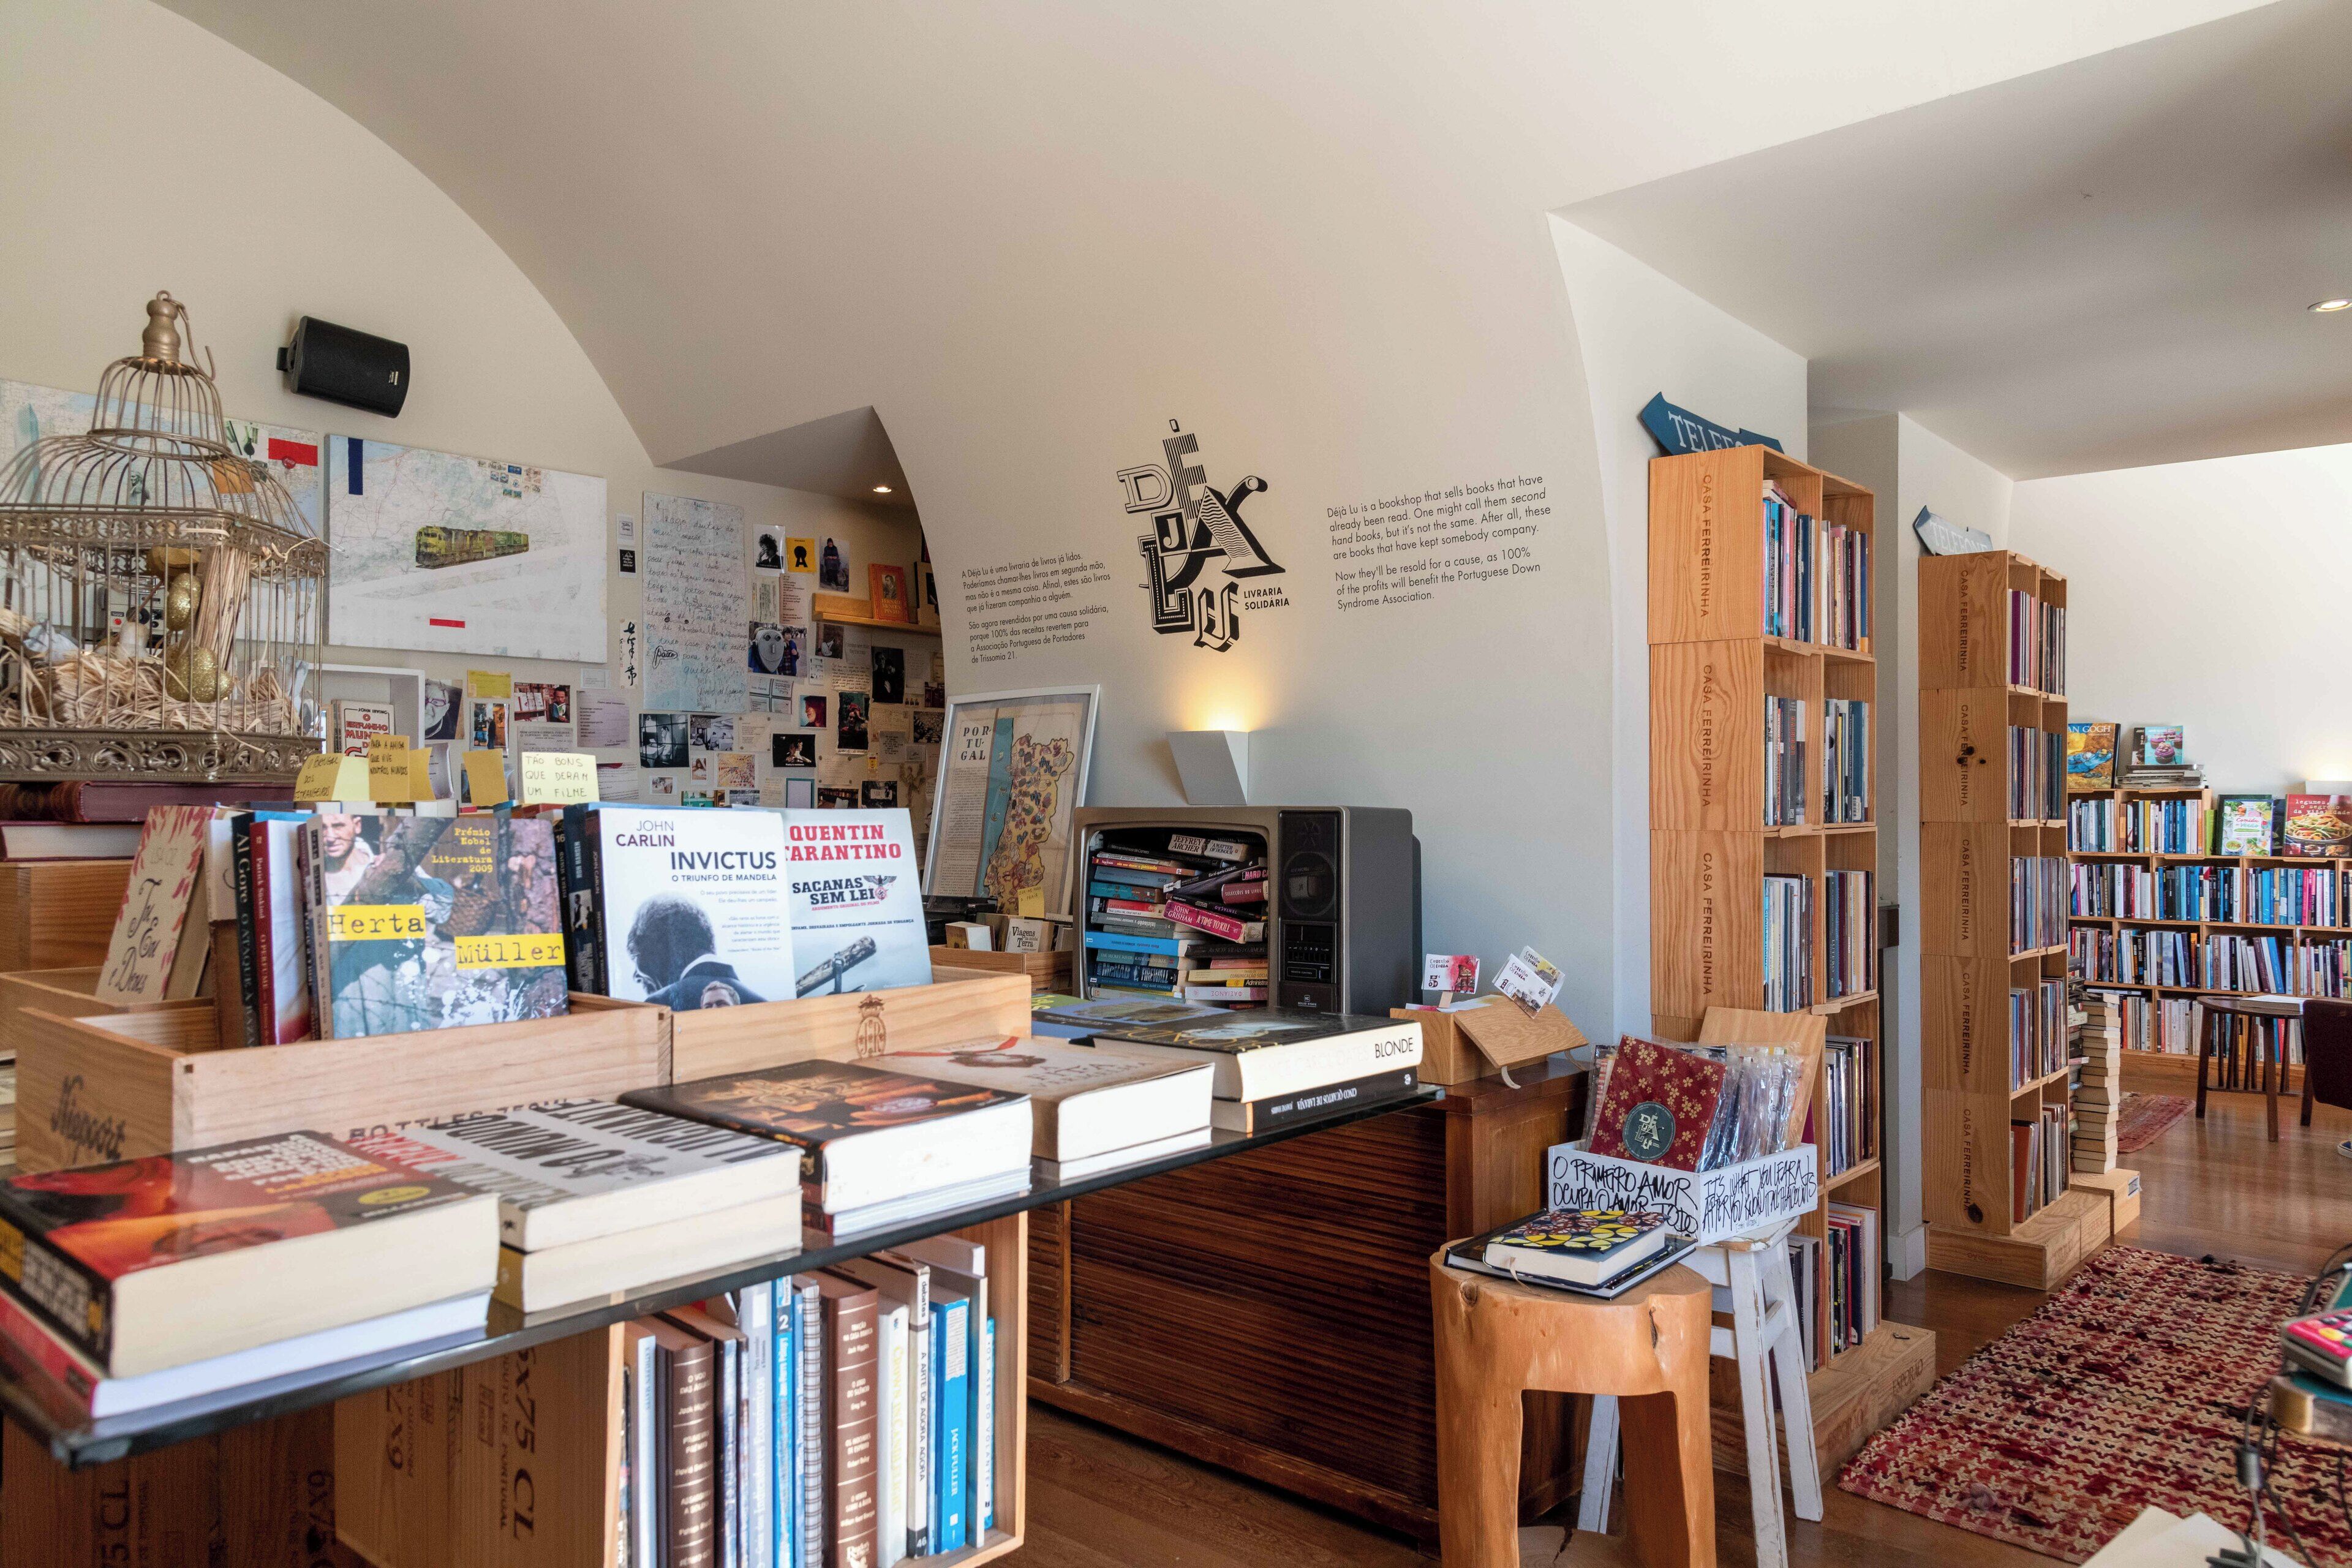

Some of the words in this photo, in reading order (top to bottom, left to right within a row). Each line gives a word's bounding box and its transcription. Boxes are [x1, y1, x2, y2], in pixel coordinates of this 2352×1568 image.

[1327, 506, 1347, 520] Déjà
[1349, 504, 1358, 514] Lu
[1360, 503, 1368, 513] is
[1378, 494, 1422, 510] bookshop
[1424, 490, 1441, 502] that
[1444, 486, 1465, 499] sells
[1466, 481, 1494, 495] books
[1497, 478, 1515, 490] that
[1518, 475, 1543, 487] have
[1703, 474, 1712, 514] CASA
[1329, 517, 1361, 532] already
[1363, 516, 1385, 527] been
[1387, 509, 1411, 523] read.
[1414, 508, 1434, 518] One
[1437, 501, 1463, 516] might
[1464, 497, 1481, 511] call
[1484, 496, 1507, 508] them
[1511, 487, 1546, 504] second
[1332, 532, 1353, 546] hand
[1355, 529, 1383, 543] books,
[1385, 527, 1400, 538] but
[1417, 522, 1431, 533] not
[1433, 519, 1447, 531] the
[1450, 518, 1478, 529] same.
[1480, 511, 1504, 524] After
[1507, 507, 1521, 521] all,
[1525, 505, 1551, 518] these
[1349, 545, 1374, 558] books
[1377, 543, 1393, 554] that
[1395, 540, 1416, 551] have
[1419, 537, 1439, 549] kept
[1441, 527, 1489, 545] somebody
[1491, 524, 1539, 538] company.
[968, 568, 981, 578] Déjà
[1009, 560, 1030, 570] livraria
[1031, 558, 1039, 567] de
[1041, 557, 1057, 565] livros
[1058, 554, 1065, 565] já
[1066, 552, 1083, 562] lidos.
[1335, 571, 1356, 581] Now
[1385, 564, 1397, 575] be
[1400, 559, 1427, 573] resold
[1429, 558, 1442, 570] for
[1453, 556, 1483, 566] cause,
[1501, 546, 1531, 560] 100%
[1700, 519, 1711, 618] FERREIRINHA
[963, 578, 996, 589] Poderíamos
[998, 573, 1031, 585] chamar-lhes
[1033, 570, 1049, 578] livros
[1061, 565, 1087, 576] segunda
[1090, 560, 1106, 571] mão,
[1336, 584, 1345, 595] of
[1347, 583, 1359, 594] the
[1362, 579, 1389, 597] profits
[1390, 576, 1406, 589] will
[1408, 573, 1439, 587] benefit
[1441, 571, 1455, 583] the
[1458, 568, 1509, 581] Portuguese
[1512, 564, 1540, 575] Down
[978, 591, 989, 600] não
[1023, 584, 1041, 593] coisa.
[1042, 580, 1062, 590] Afinal,
[1080, 576, 1092, 584] são
[1094, 573, 1110, 582] livros
[1244, 587, 1283, 598] LIVRARIA
[1960, 570, 1969, 598] CASA
[1245, 597, 1290, 610] SOLIDÁRIA
[1338, 597, 1380, 612] Syndrome
[1382, 591, 1434, 605] Association.
[1959, 601, 1968, 672] FERREIRINHA
[1703, 665, 1712, 704] CASA
[525, 753, 545, 764] TÃO
[555, 757, 584, 767] BONS
[960, 750, 986, 761] GAL
[1702, 709, 1711, 808] FERREIRINHA
[526, 771, 546, 780] QUE
[555, 772, 588, 782] DERAM
[527, 786, 543, 796] UM
[454, 827, 491, 837] Prémio
[636, 820, 674, 831] JOHN
[790, 824, 884, 841] QUENTIN
[461, 837, 491, 845] Nobel
[616, 834, 675, 846] CARLIN
[1171, 842, 1200, 853] ARCHER
[1174, 835, 1203, 846] JEFFREY
[431, 854, 493, 864] Literatura
[480, 846, 491, 854] de
[469, 864, 493, 873] 2009
[671, 851, 777, 870] INVICTUS
[1703, 853, 1712, 892] CASA
[792, 877, 863, 894] SACANAS
[810, 891, 845, 905] SEM
[850, 888, 875, 901] LEI
[1167, 910, 1193, 924] GRISHAM
[1173, 905, 1189, 915] JOHN
[327, 913, 424, 935] Herta
[1012, 926, 1036, 938] Viagens
[1196, 915, 1200, 924] A
[1201, 916, 1213, 927] TIME
[1212, 919, 1220, 930] TO
[1219, 921, 1231, 933] KILL
[1017, 938, 1034, 948] Terra
[1703, 897, 1712, 995] FERREIRINHA
[456, 943, 561, 964] Müller
[1140, 967, 1169, 984] FIREWALL
[1375, 1037, 1414, 1058] BLONDE
[1553, 1156, 1568, 1179] O
[1570, 1159, 1637, 1193] PRIMEIRO
[1637, 1170, 1698, 1210] AMOR
[920, 1391, 927, 1403] DE
[951, 1428, 959, 1453] JACK
